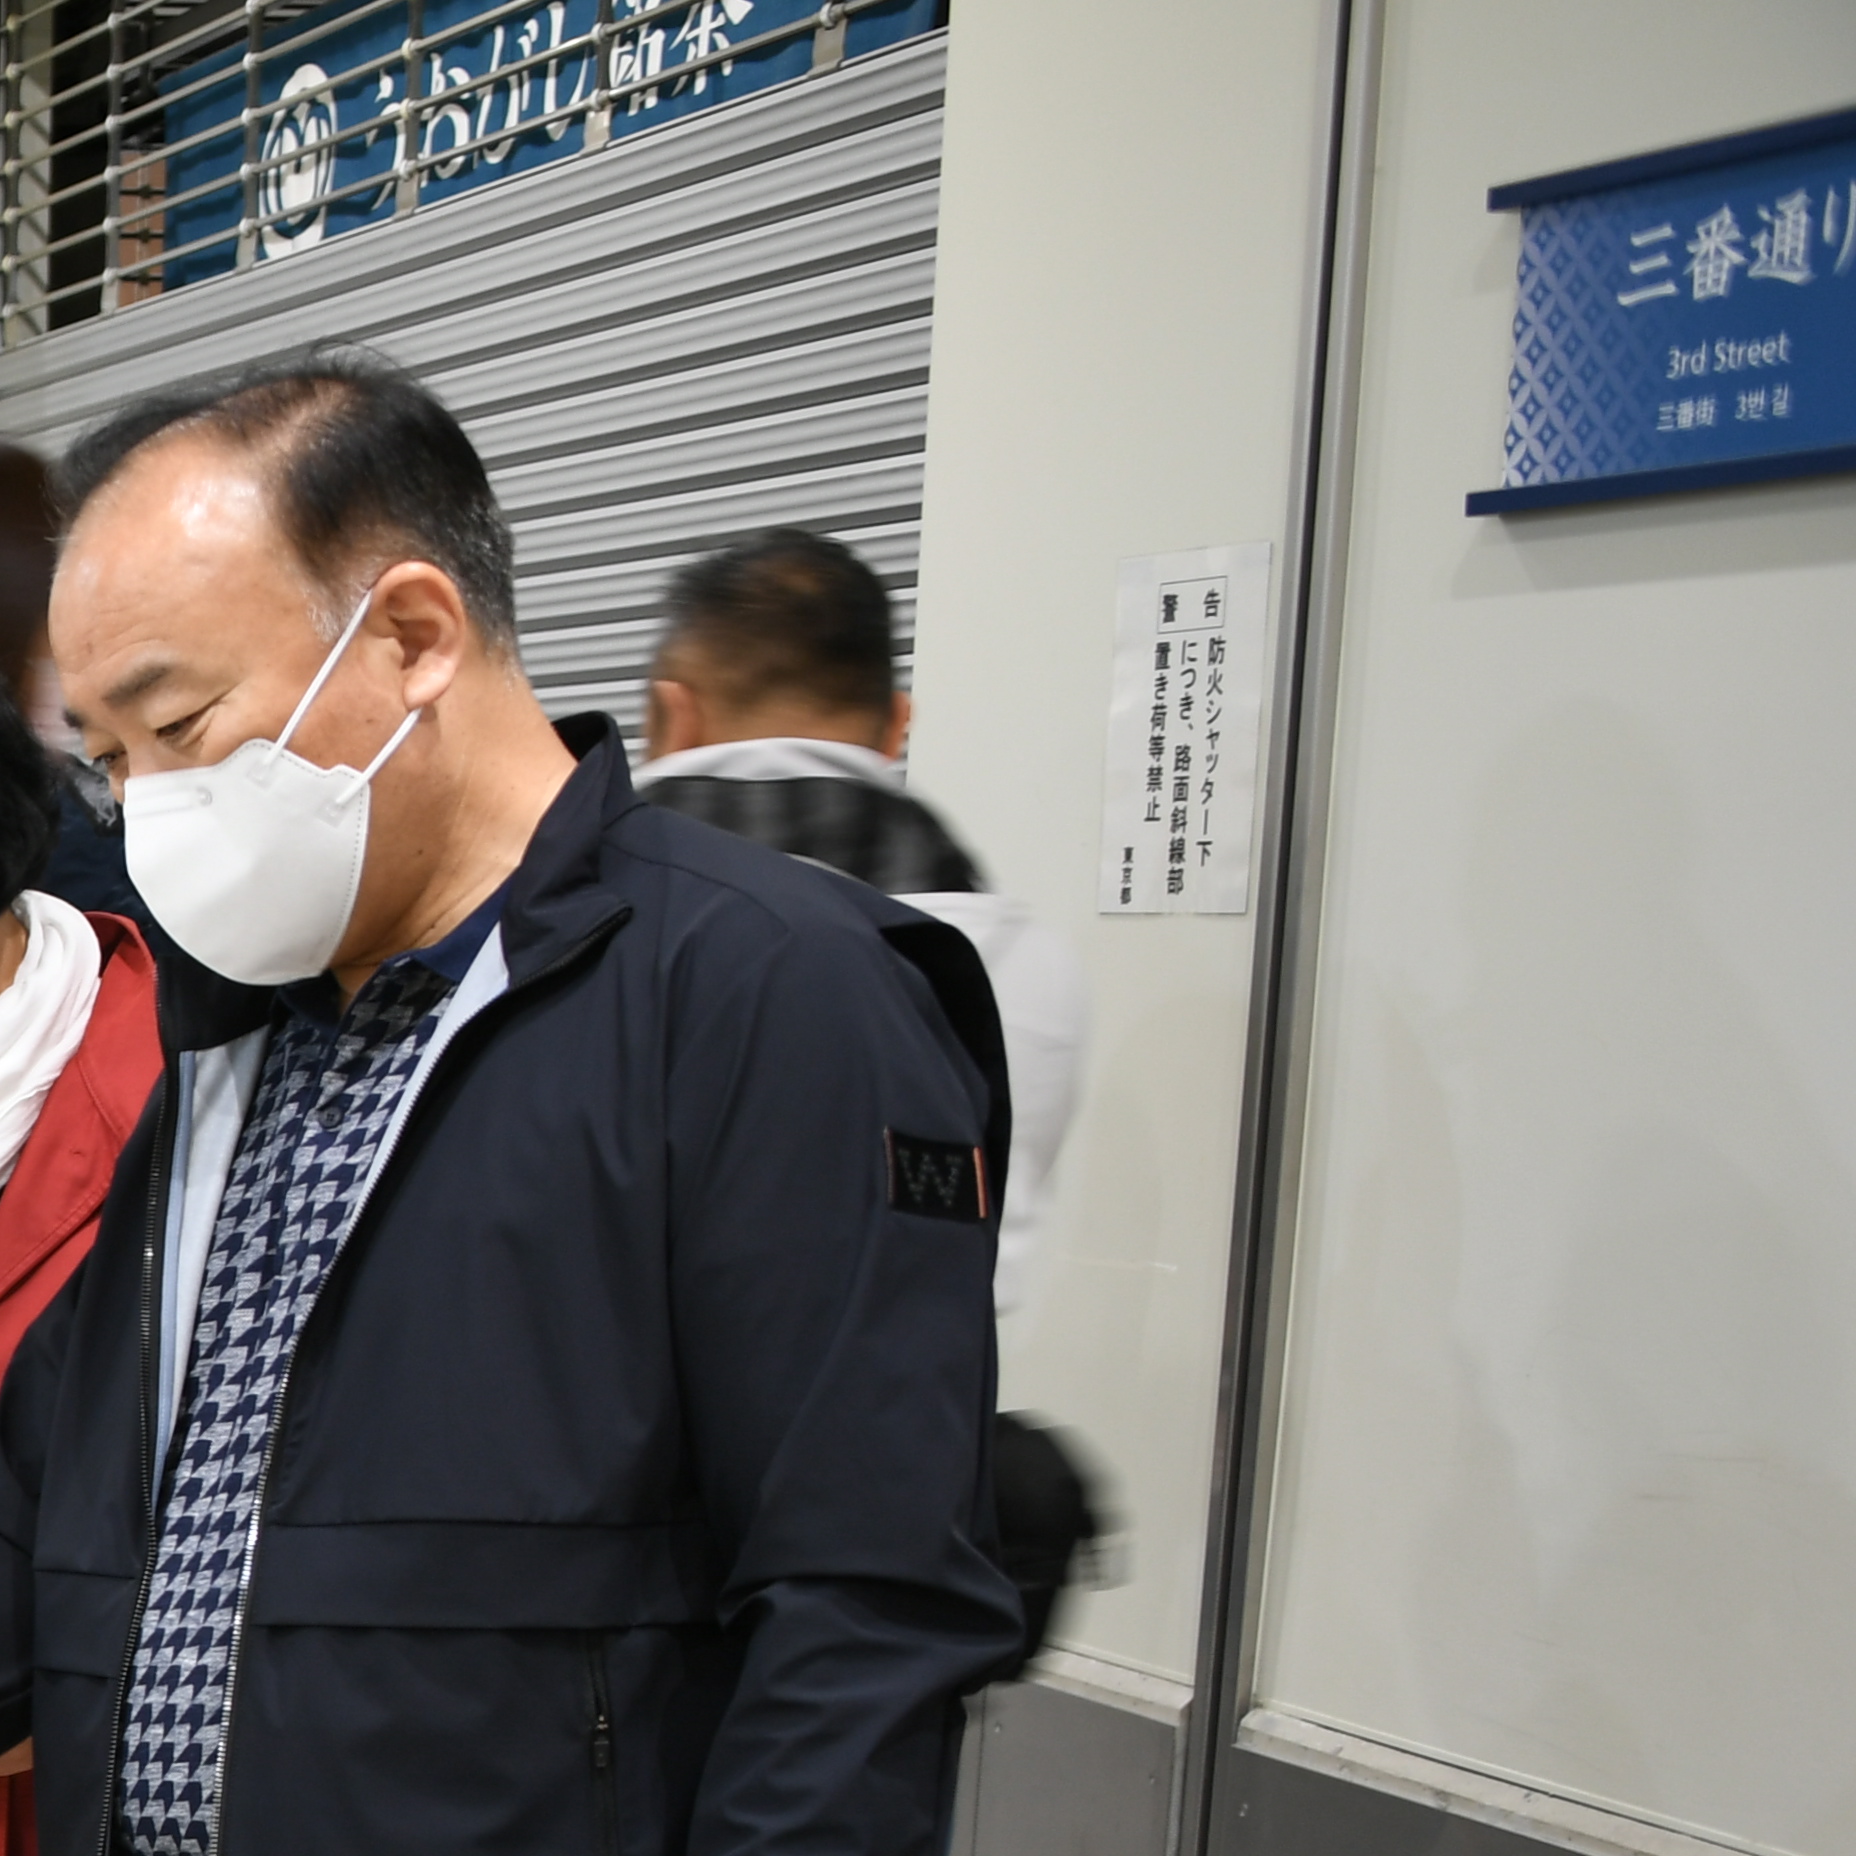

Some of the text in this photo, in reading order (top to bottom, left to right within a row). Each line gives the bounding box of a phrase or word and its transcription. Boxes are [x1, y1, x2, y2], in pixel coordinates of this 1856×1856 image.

[1666, 329, 1792, 380] 3rd Street
[1656, 395, 1716, 431] 三番街
[1161, 588, 1222, 624] 警告
[1144, 642, 1171, 822] 置き荷等禁止
[1196, 635, 1227, 867] 防火シャッター下
